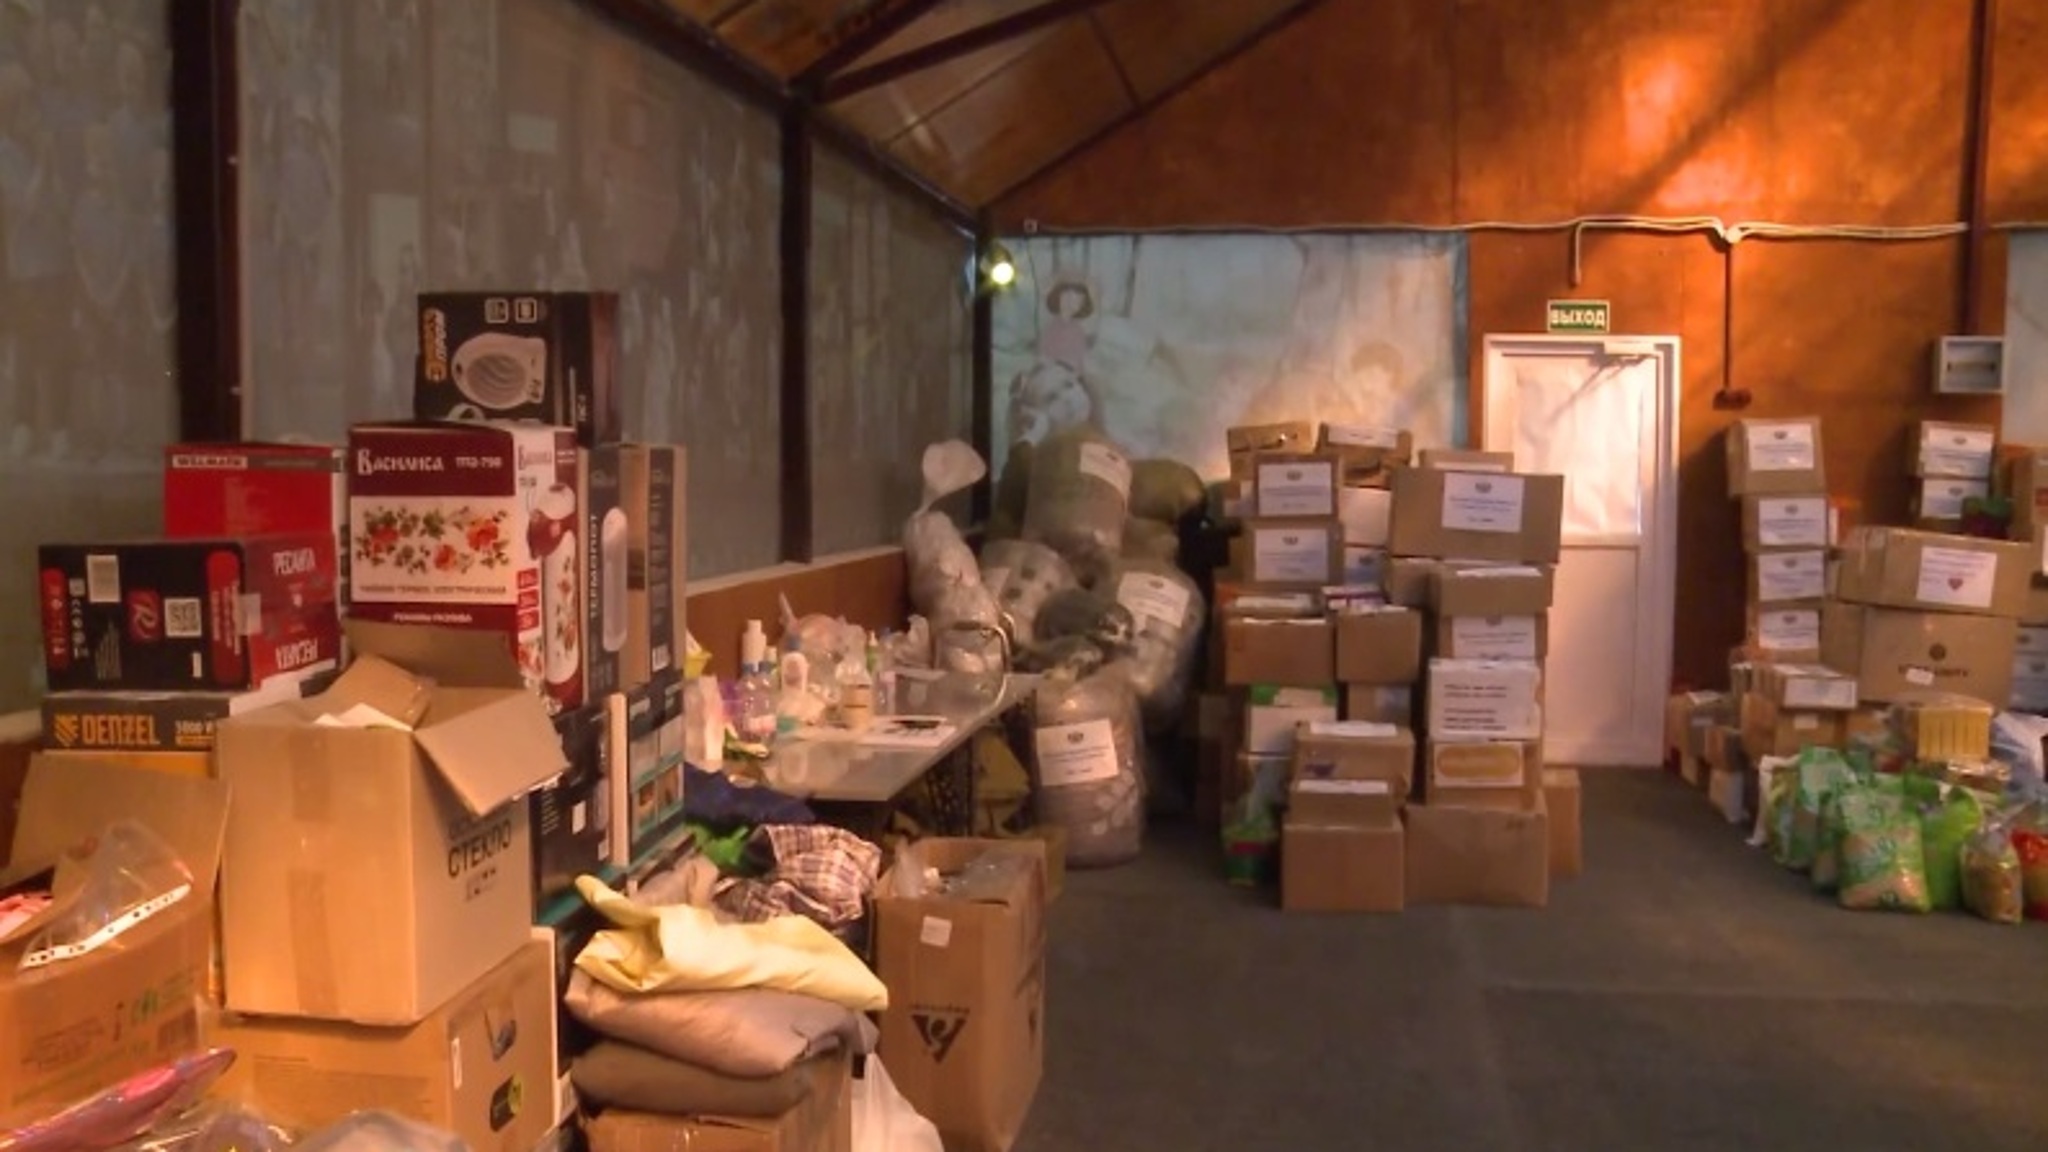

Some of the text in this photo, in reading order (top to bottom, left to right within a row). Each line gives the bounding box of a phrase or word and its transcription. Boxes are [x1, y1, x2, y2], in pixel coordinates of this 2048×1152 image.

[1550, 309, 1605, 327] ВЫХОД
[82, 714, 160, 745] DENZEL
[448, 818, 511, 879] СТЕКЛО
